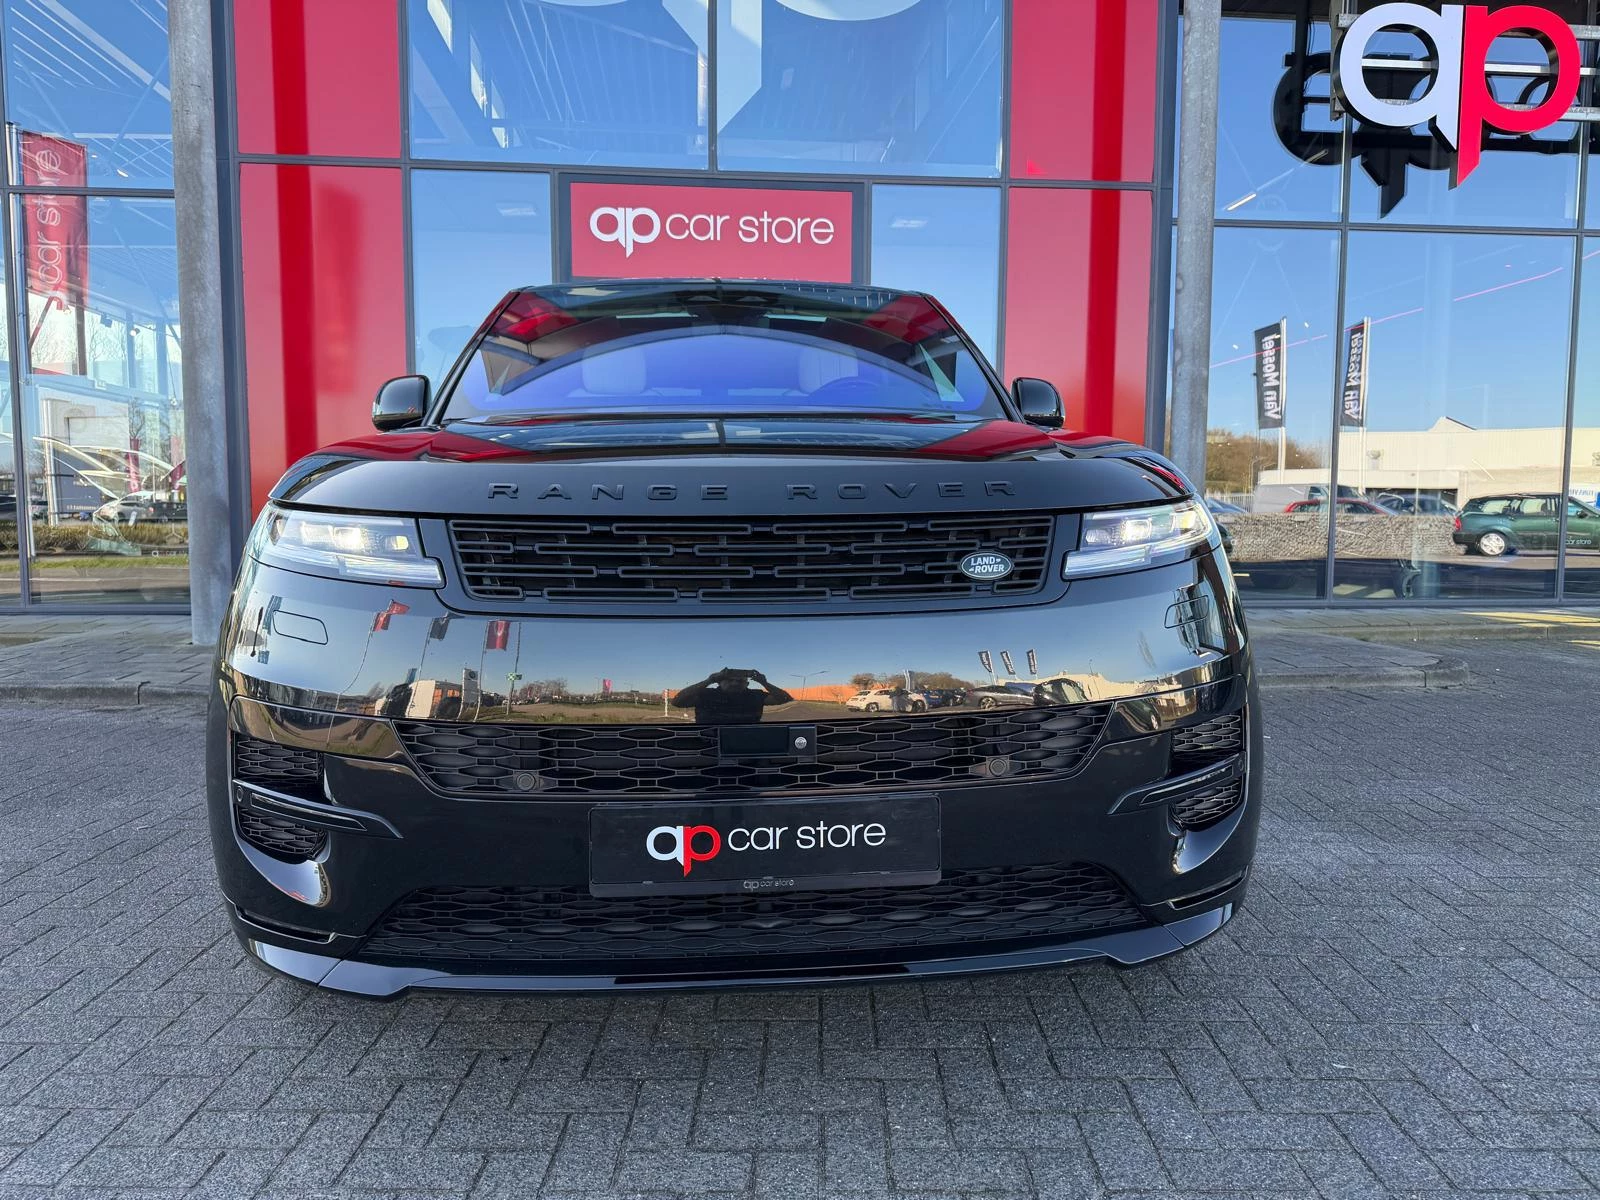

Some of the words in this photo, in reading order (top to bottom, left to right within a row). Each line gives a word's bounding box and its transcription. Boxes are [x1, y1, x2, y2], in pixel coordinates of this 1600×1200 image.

[1339, 2, 1581, 188] ap
[38, 231, 62, 284] car
[589, 206, 661, 259] ap
[665, 213, 730, 241] car
[738, 210, 835, 245] store
[487, 482, 730, 501] RANGE
[785, 480, 1016, 500] ROVER
[971, 556, 995, 566] LAND
[974, 564, 1005, 574] ROVER
[646, 824, 721, 878] ap
[727, 826, 788, 852] car
[796, 820, 887, 849] store
